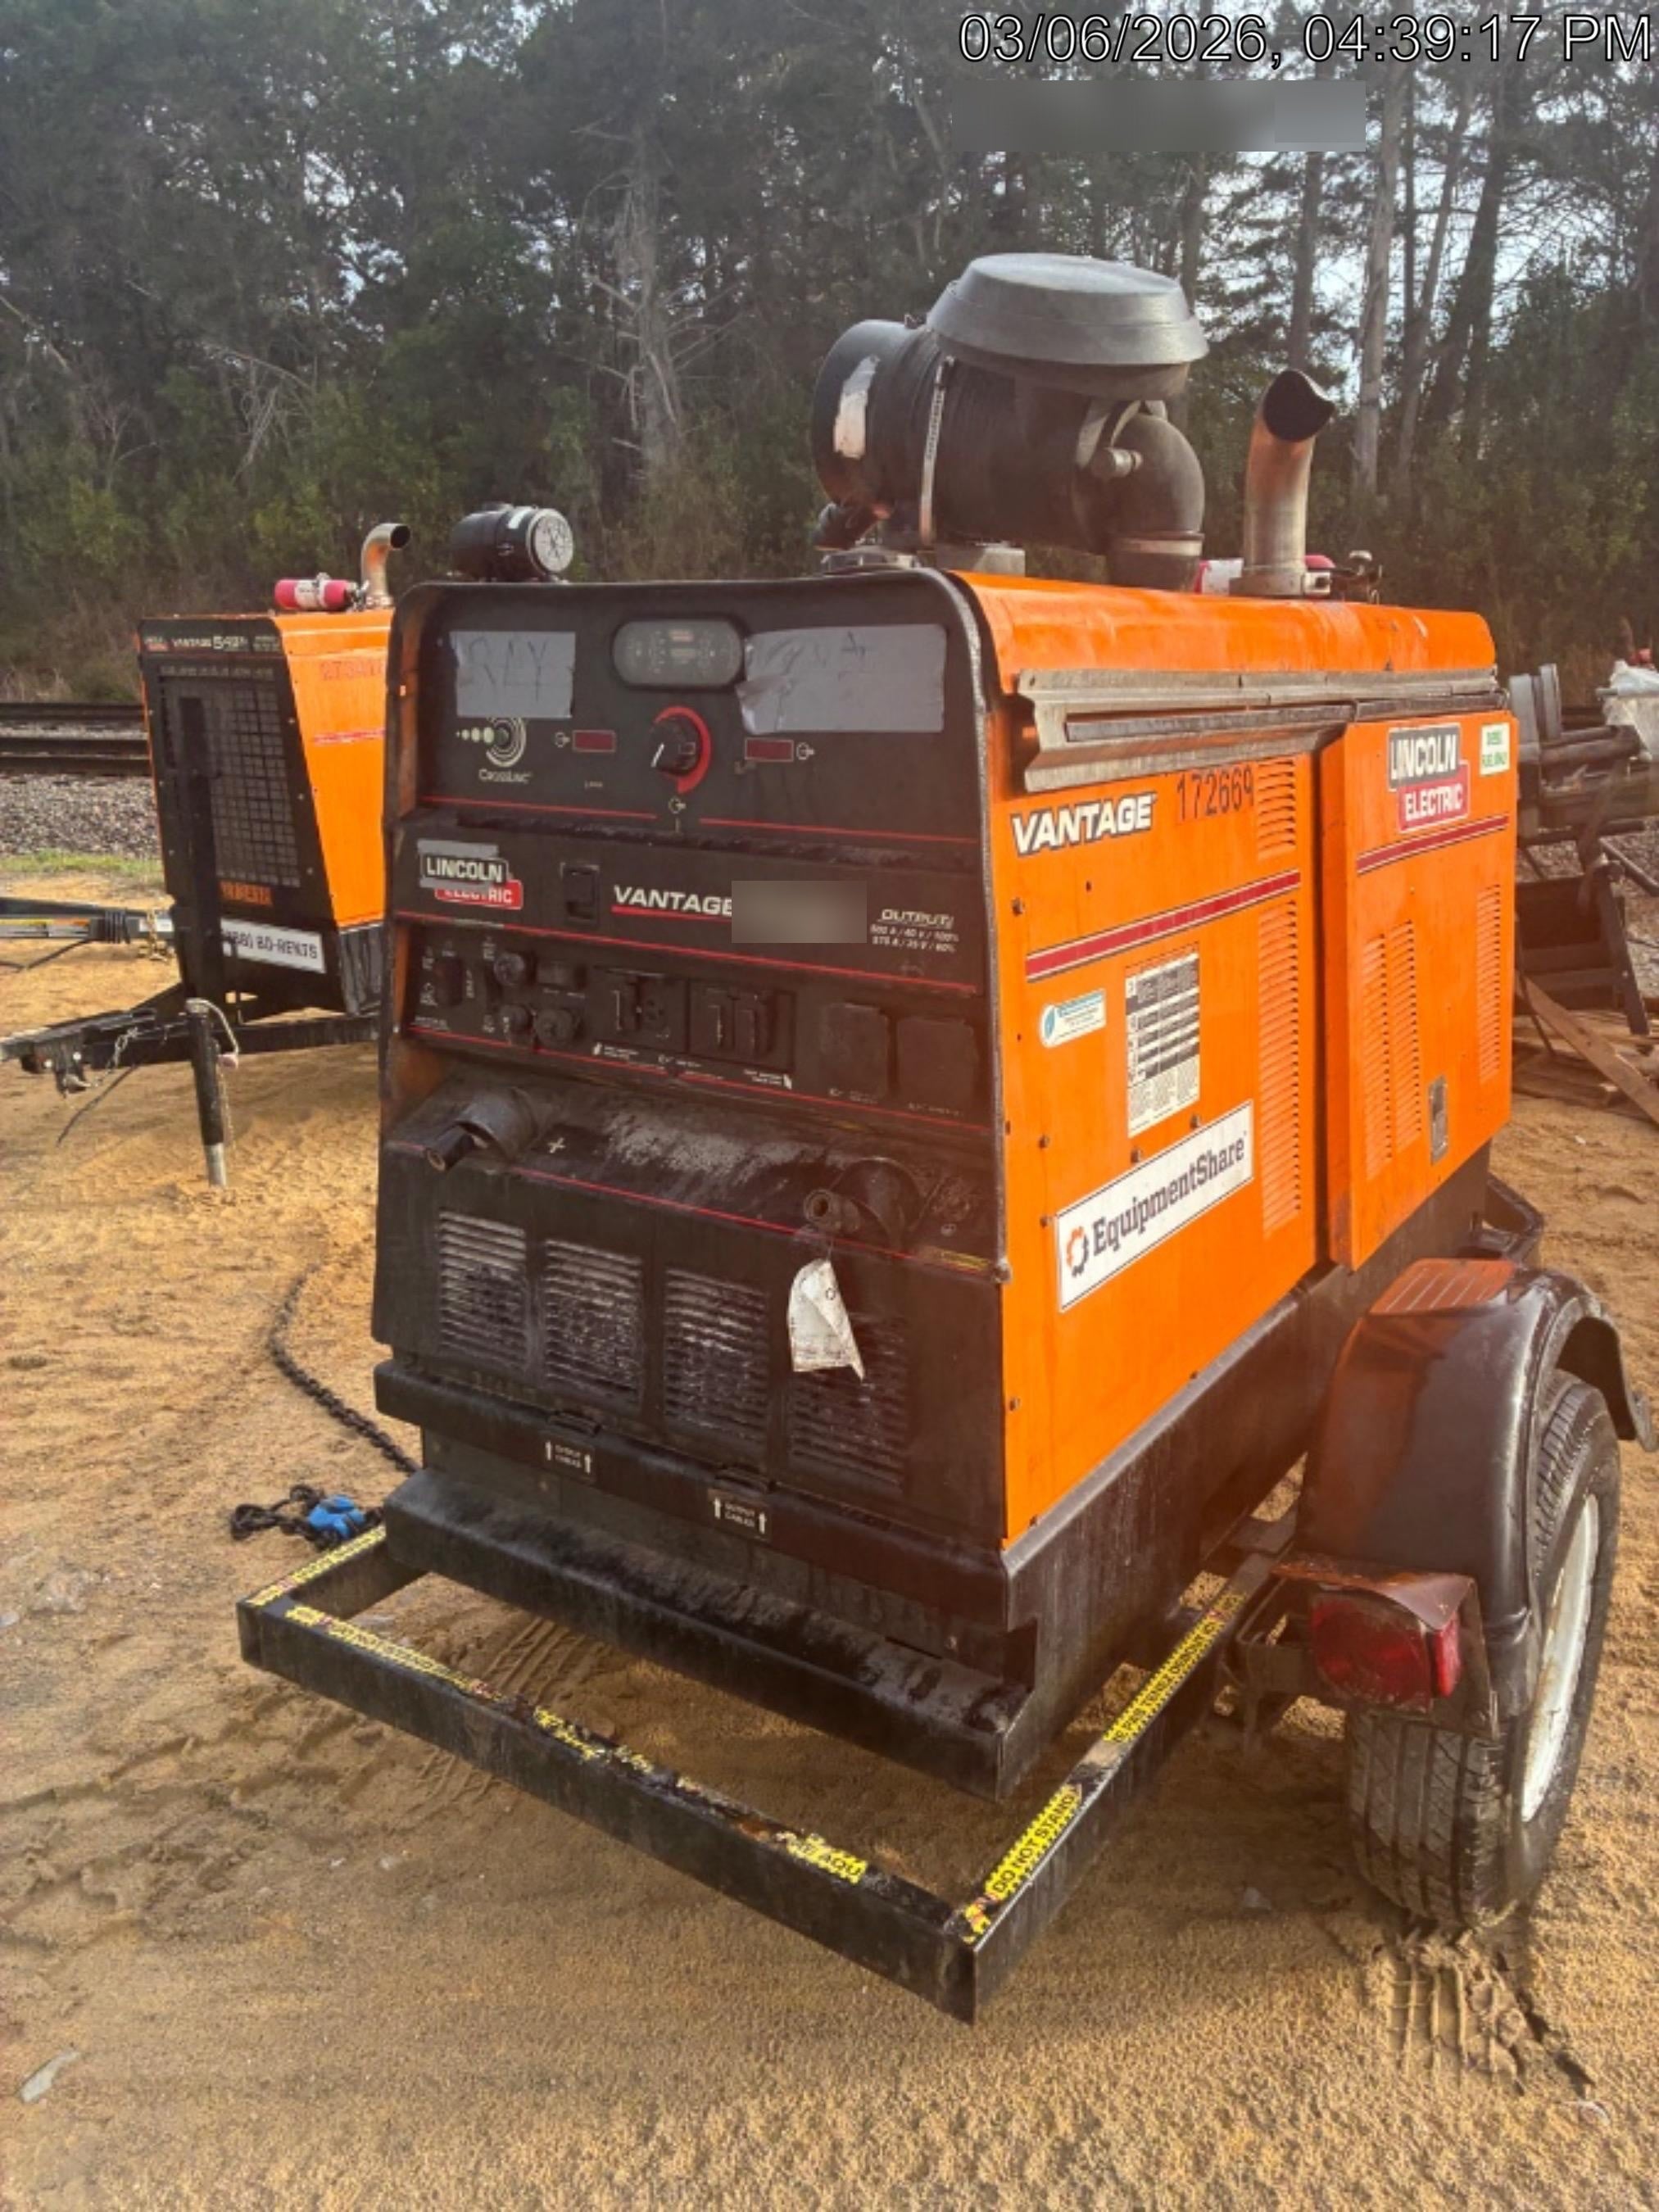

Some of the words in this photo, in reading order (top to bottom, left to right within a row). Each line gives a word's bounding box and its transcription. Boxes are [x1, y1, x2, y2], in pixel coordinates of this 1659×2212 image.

[1389, 734, 1457, 781] LINCOLN
[1176, 766, 1254, 820] 172669
[1404, 783, 1464, 822] ELECTRIC
[1011, 792, 1153, 855] VANTAGE
[426, 856, 503, 884] LINCOLN
[614, 885, 732, 916] VANTAGE
[882, 909, 950, 926] OUTPUT
[1092, 1137, 1244, 1257] EquipmentShare
[992, 1869, 1017, 1893] DO
[1012, 1837, 1038, 1870] NOT
